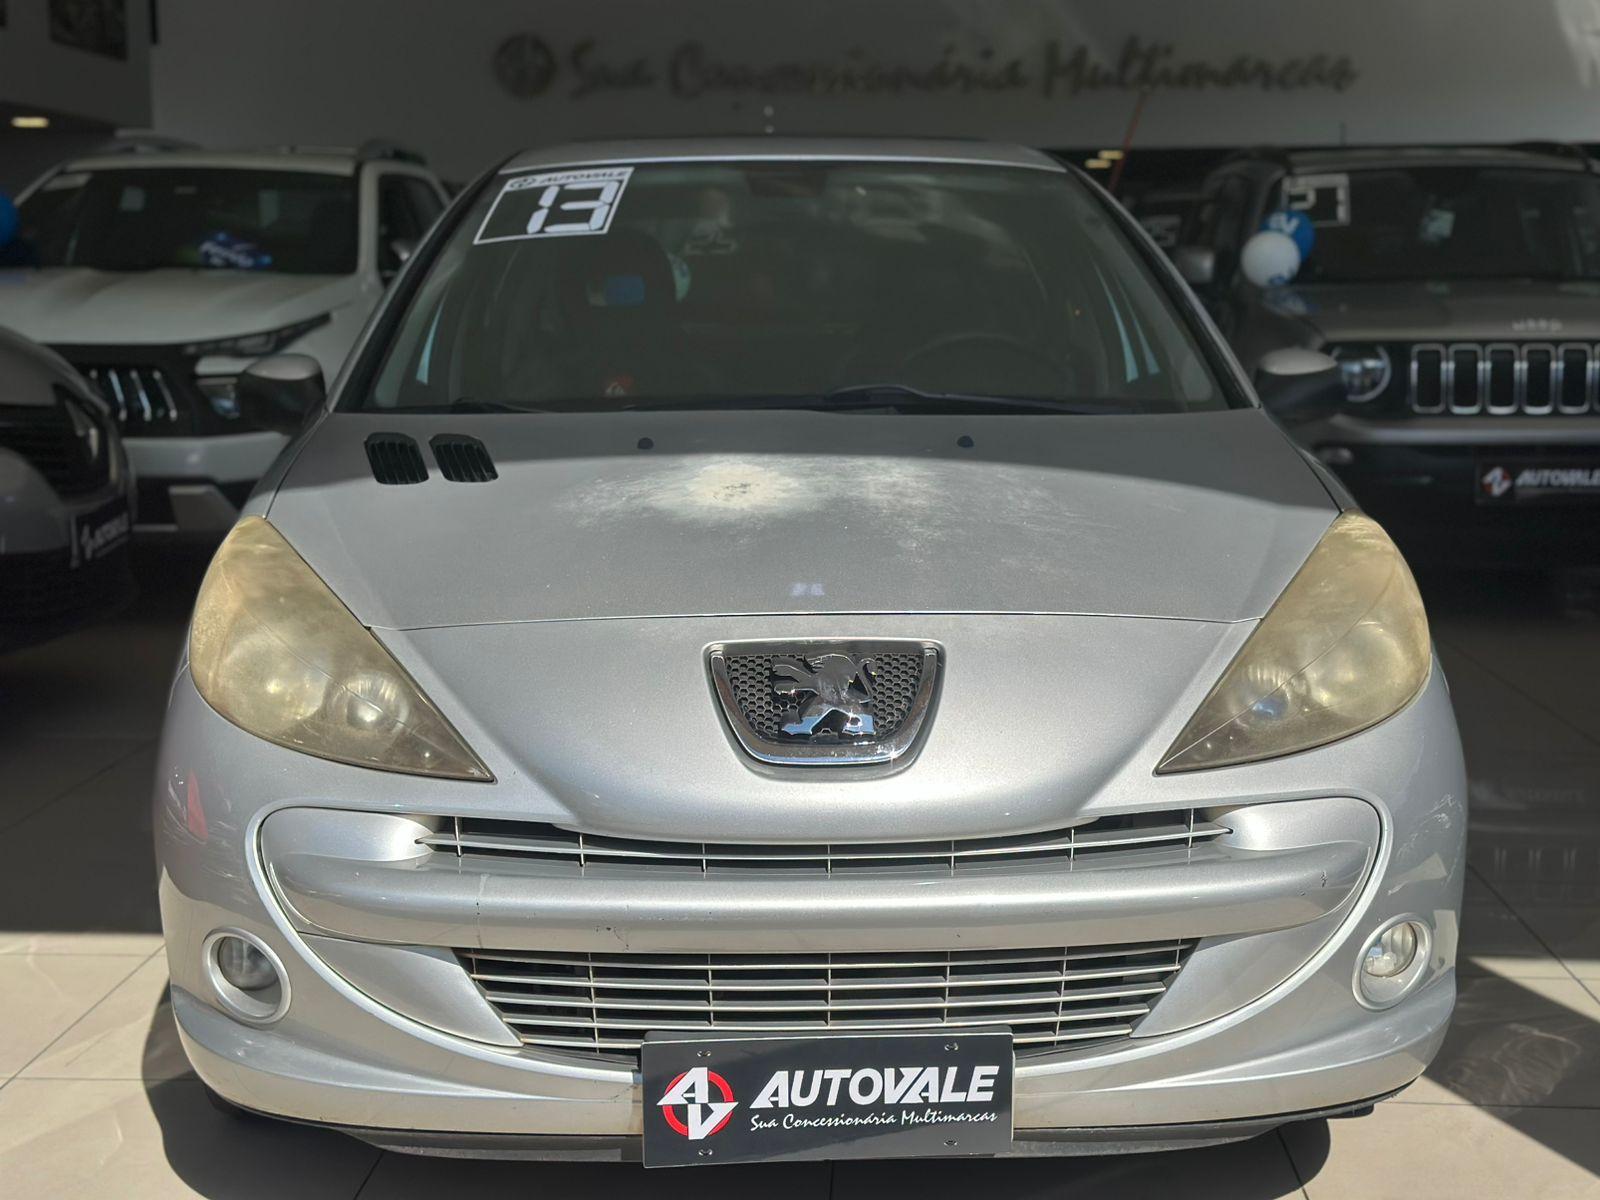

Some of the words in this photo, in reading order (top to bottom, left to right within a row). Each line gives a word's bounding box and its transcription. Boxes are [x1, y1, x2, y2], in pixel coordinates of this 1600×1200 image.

[526, 180, 620, 234] 13
[749, 1065, 999, 1109] AUTOVALE
[750, 1116, 778, 1132] Sua
[782, 1111, 897, 1129] Concessionária
[900, 1108, 998, 1125] Multimarcas
